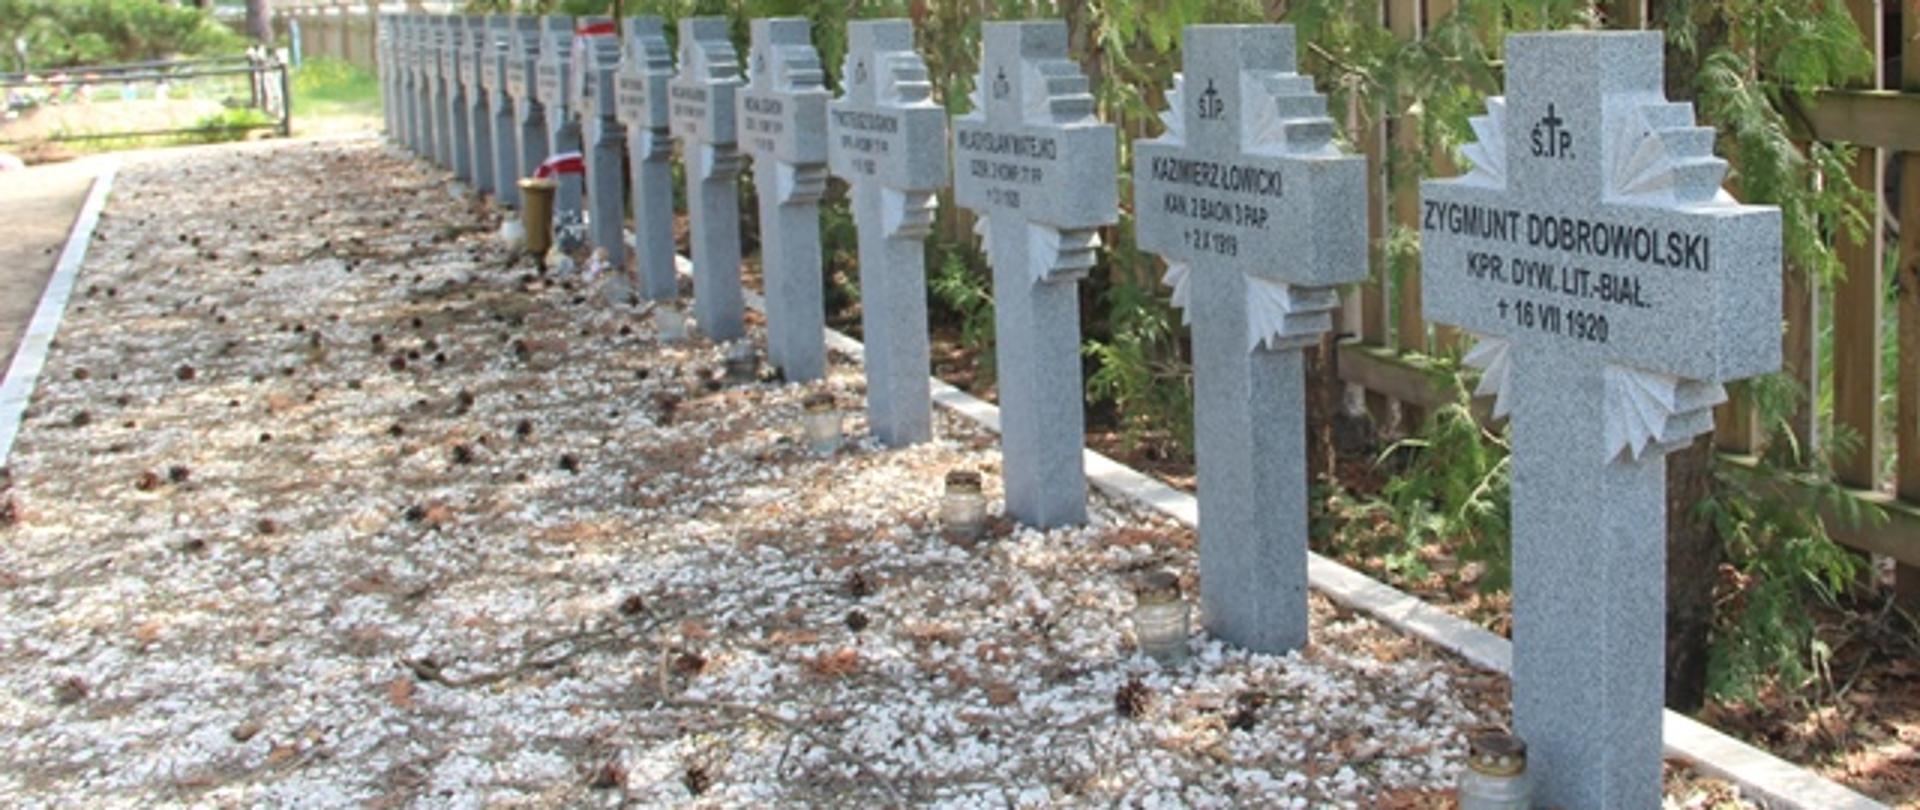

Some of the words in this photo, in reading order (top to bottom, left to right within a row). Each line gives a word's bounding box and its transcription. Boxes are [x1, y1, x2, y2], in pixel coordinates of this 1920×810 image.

[1152, 156, 1219, 189] KAZIMIERZ
[1220, 164, 1283, 197] ŁOWICKI
[1191, 197, 1198, 218] 2
[1200, 199, 1233, 223] BAON
[1424, 200, 1520, 244] ZYGMUNT
[1526, 213, 1710, 272] DOBROWOLSKI
[1466, 251, 1508, 284] KPR.
[1512, 258, 1557, 292] DYW.
[1562, 268, 1653, 308] LIT.-BIAŁ.
[1514, 299, 1534, 328] 16
[1538, 305, 1561, 335] VII
[1566, 311, 1609, 343] 1920
